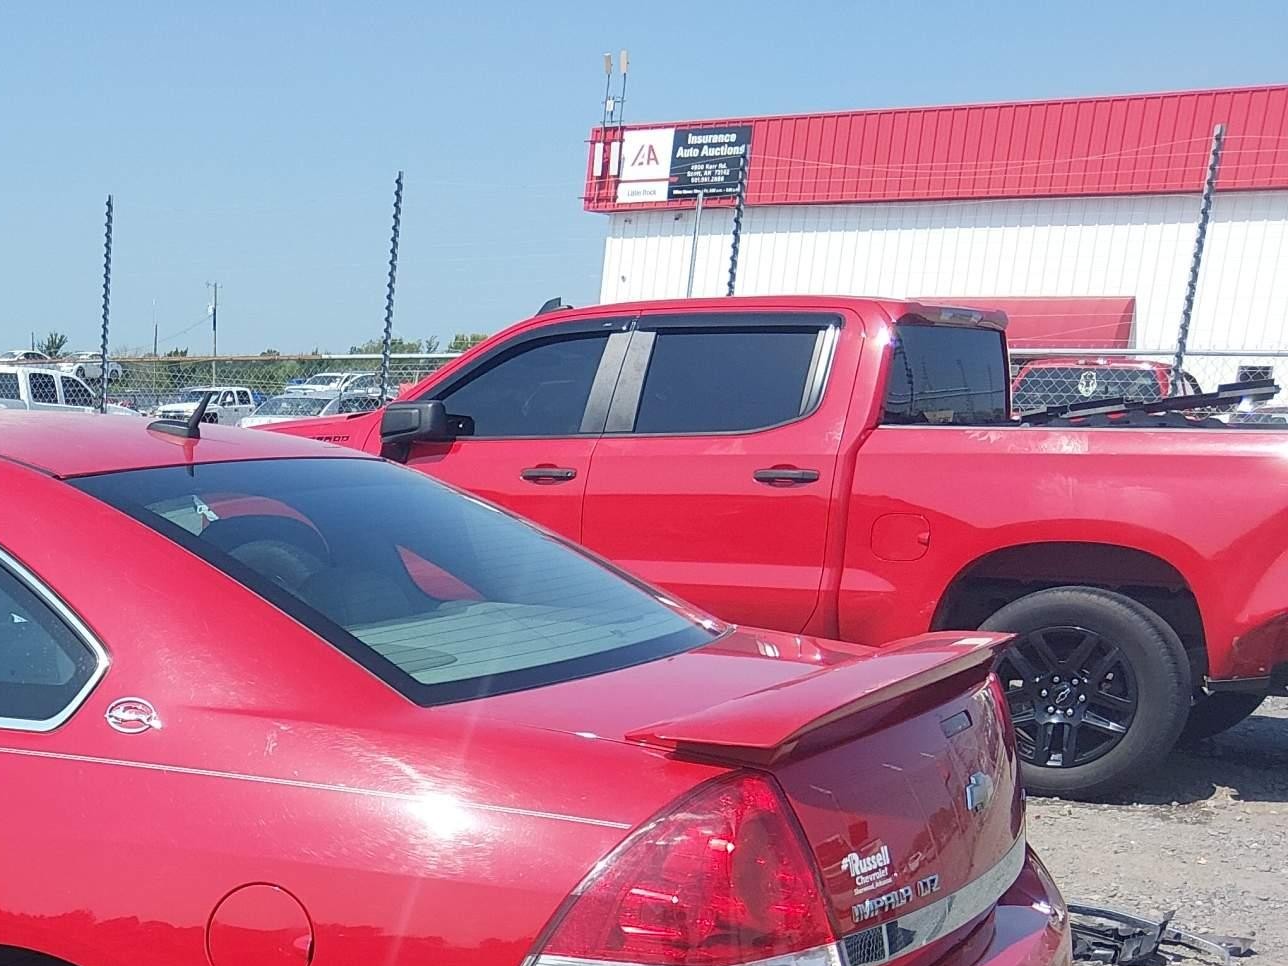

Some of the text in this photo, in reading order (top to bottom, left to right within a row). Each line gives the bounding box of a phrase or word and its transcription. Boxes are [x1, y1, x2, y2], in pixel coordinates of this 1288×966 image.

[687, 133, 737, 145] Insurance
[676, 144, 746, 158] Auto Auctions
[855, 866, 888, 886] Chevrolet
[851, 885, 913, 923] IMPALA
